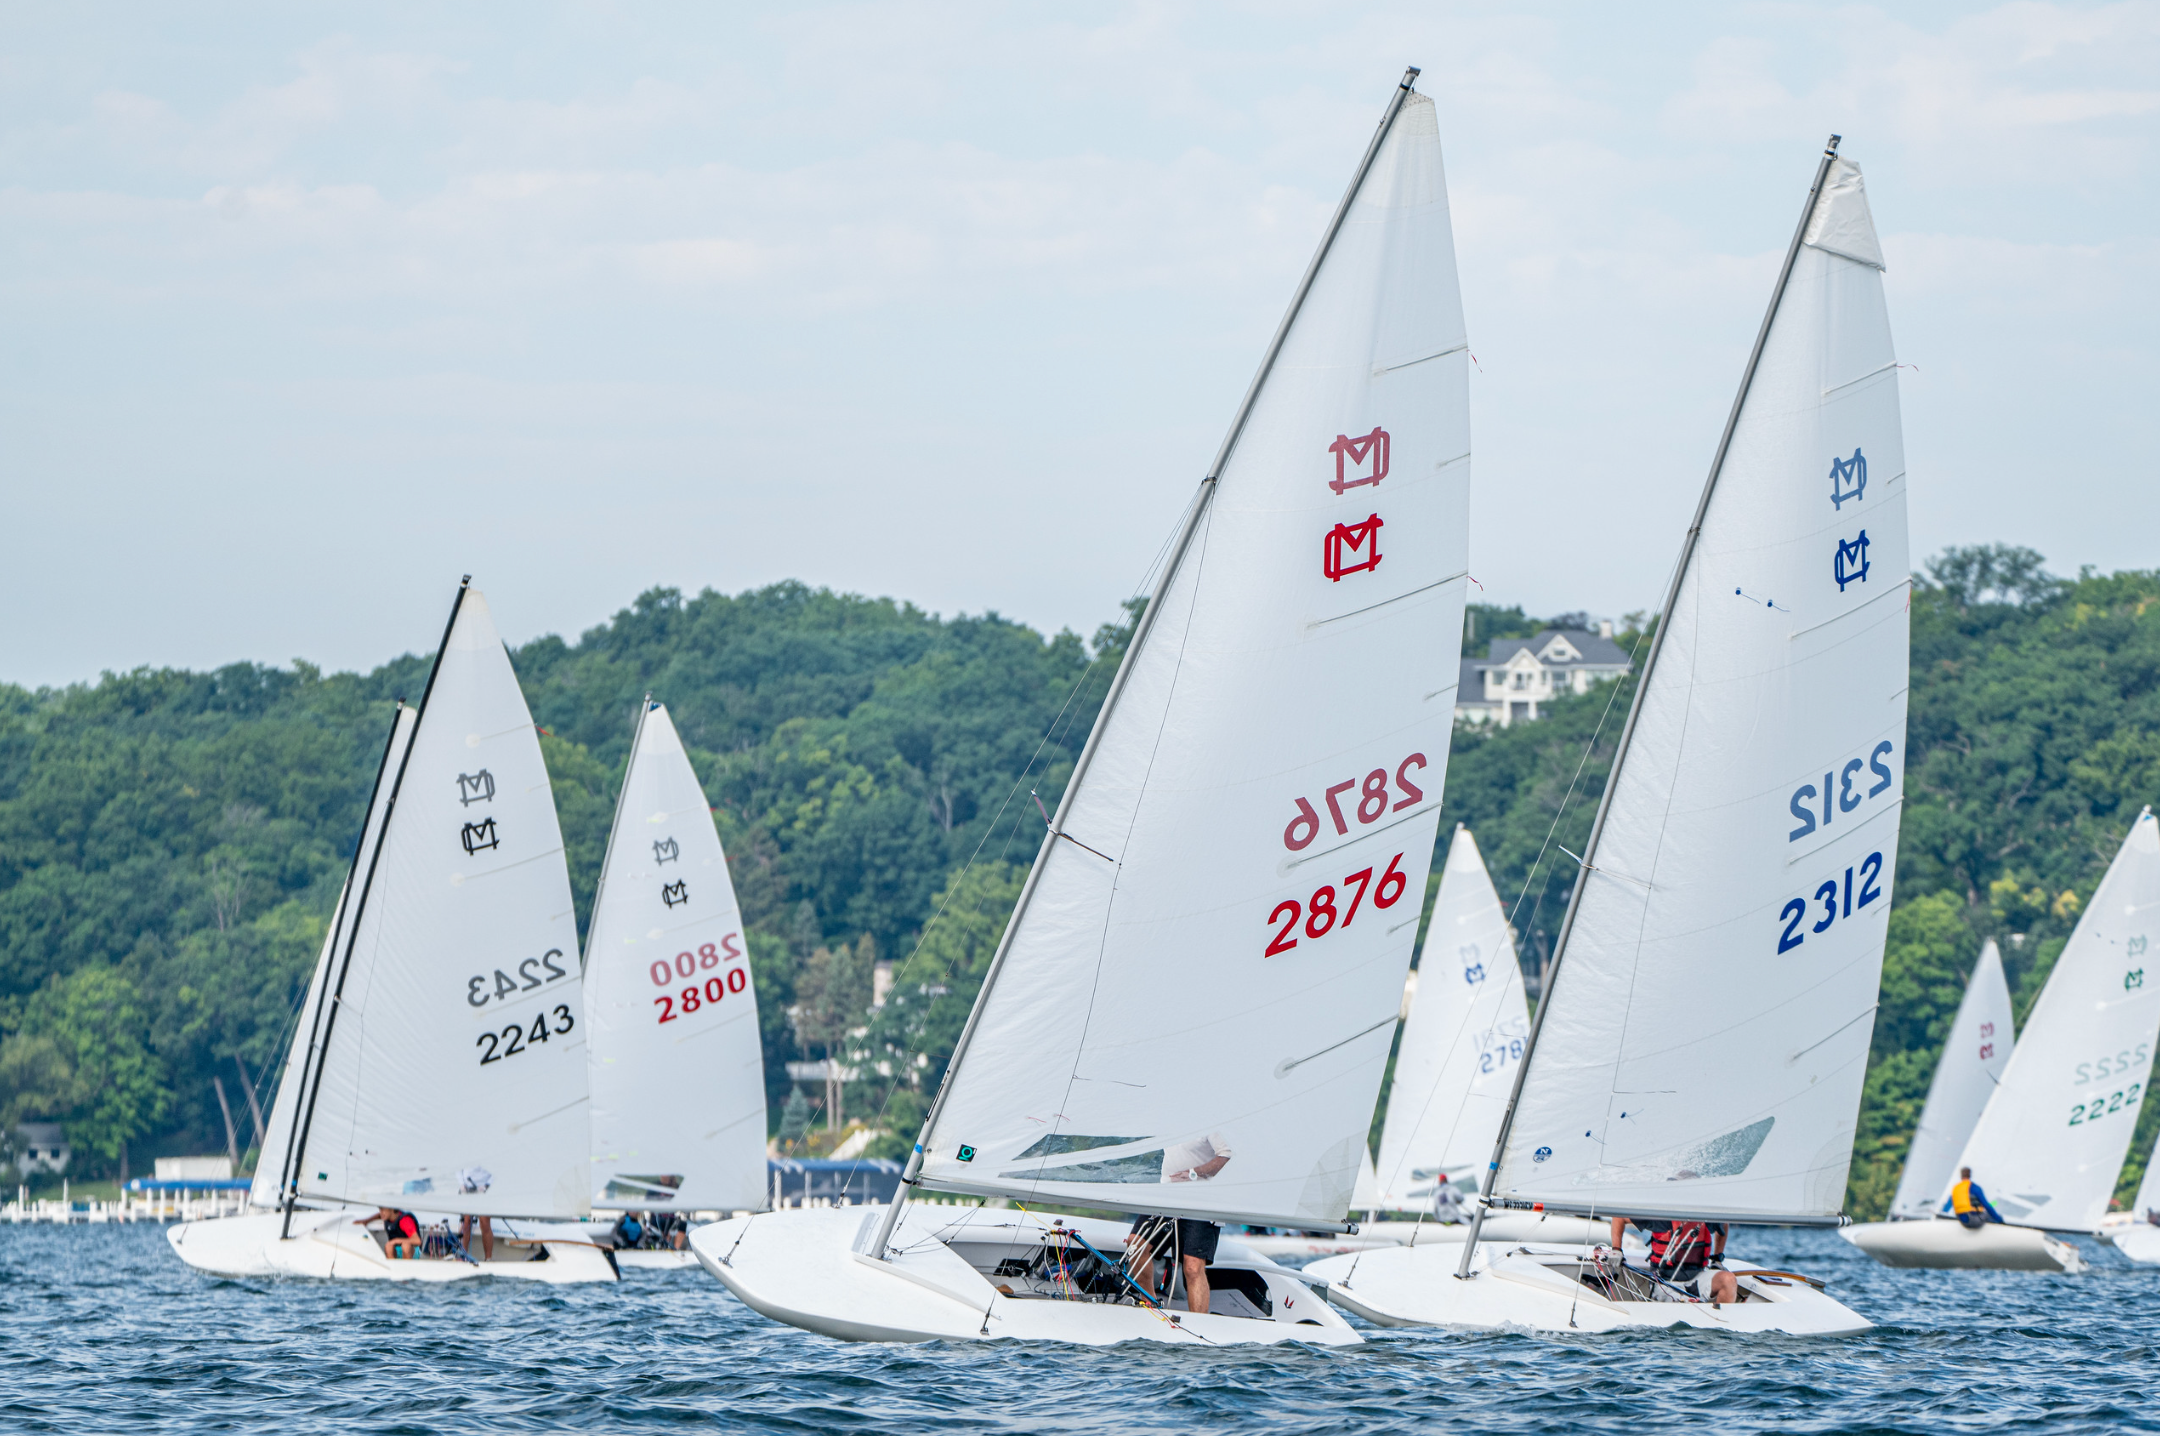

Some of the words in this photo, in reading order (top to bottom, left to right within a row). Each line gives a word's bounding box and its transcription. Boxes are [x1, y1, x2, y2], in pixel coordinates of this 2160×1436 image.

[1265, 852, 1406, 958] 2876
[1778, 852, 1882, 955] 2312
[654, 967, 746, 1024] 2800
[476, 1004, 574, 1066] 2243
[2068, 1083, 2141, 1127] 2222
